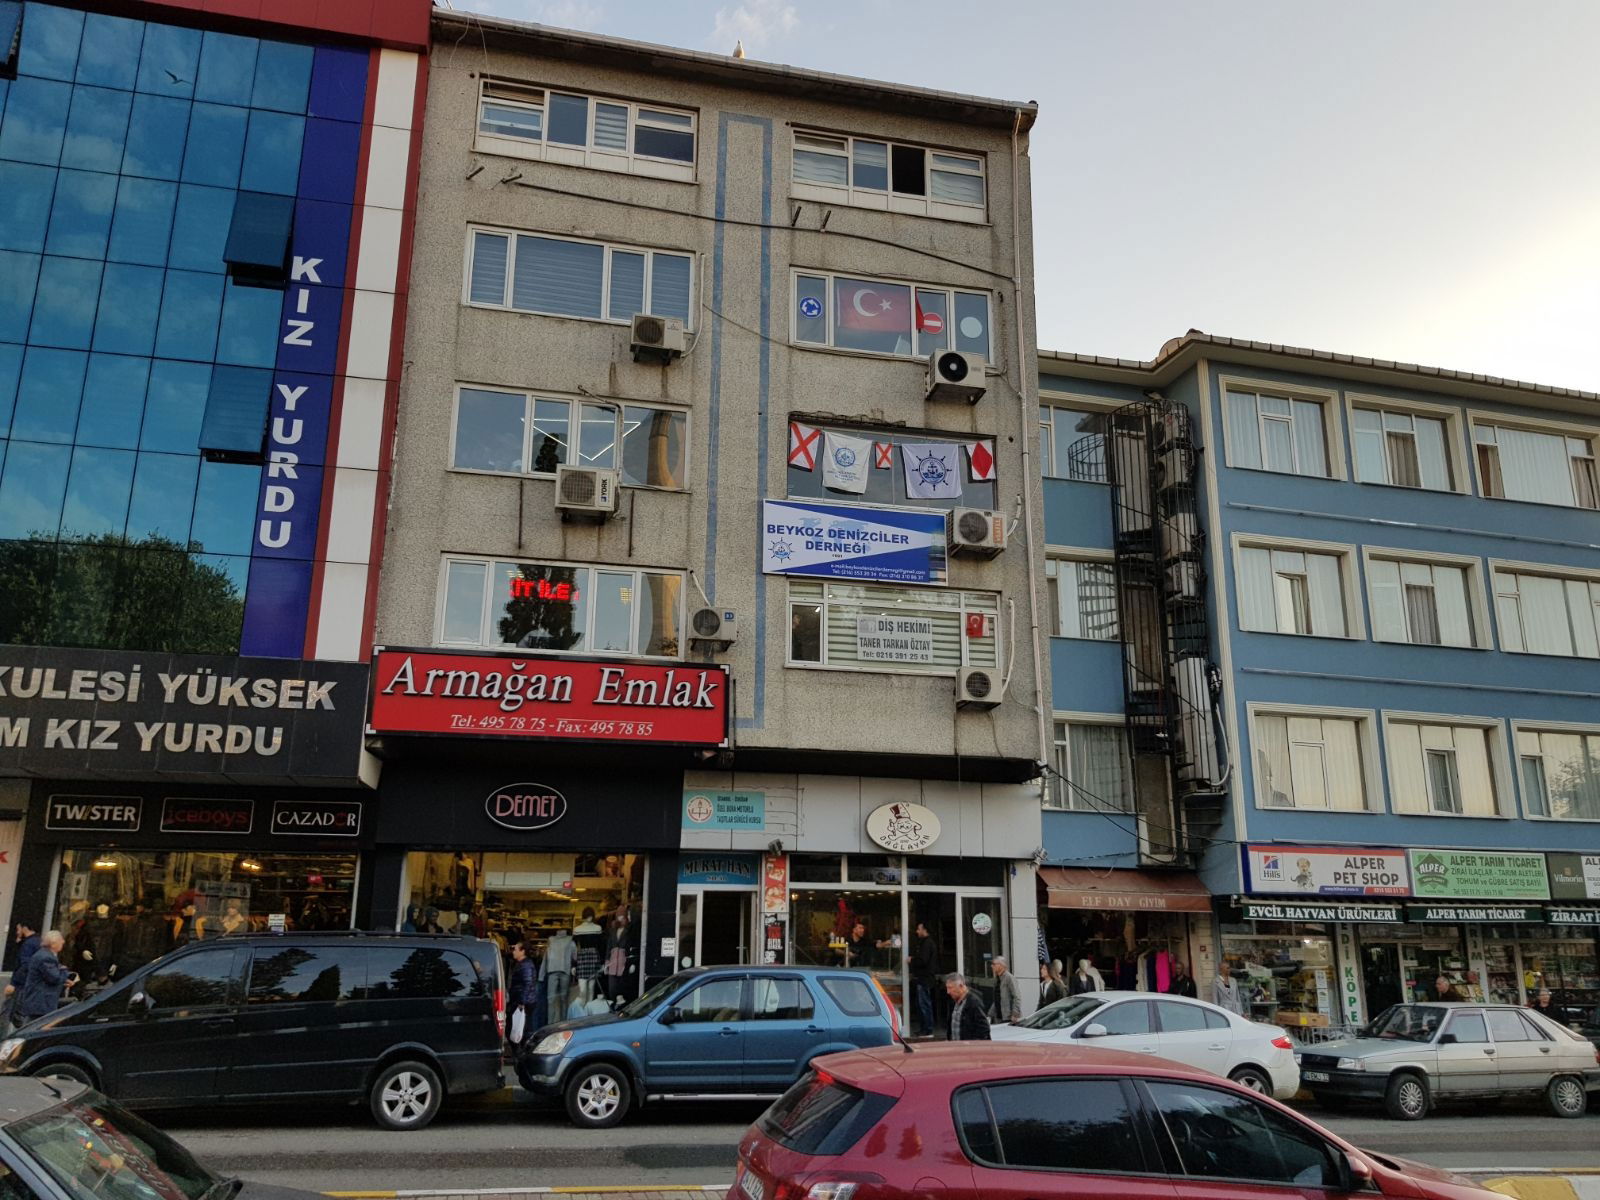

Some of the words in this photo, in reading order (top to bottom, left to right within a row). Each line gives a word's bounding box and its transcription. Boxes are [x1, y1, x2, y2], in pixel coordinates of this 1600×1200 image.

[283, 256, 324, 346] KIZ
[259, 383, 309, 548] YURDU
[767, 524, 824, 538] BEYKOZ
[828, 528, 909, 544] DENİZCİLER
[805, 541, 867, 554] DERNEĞİ
[878, 618, 894, 634] DİŞ
[897, 619, 931, 634] HEKİMİ
[859, 637, 881, 649] TANER
[883, 638, 909, 650] TARKAN
[910, 637, 931, 651] ÖZTAY
[863, 650, 874, 658] Tel:
[876, 651, 893, 659] 0216
[158, 668, 338, 711] YÜKSEK
[382, 656, 573, 712] Armağan
[593, 667, 719, 709] Emlak
[450, 713, 476, 729] Tel:
[479, 715, 505, 730] 495
[508, 716, 525, 731] 78
[526, 717, 545, 731] 75
[556, 719, 587, 733] Fax:
[590, 721, 615, 735] 495
[618, 722, 635, 735] 78
[637, 722, 653, 736] 85
[44, 718, 121, 750] KIZ
[134, 721, 284, 756] YURDU
[496, 795, 557, 816] DEMET
[54, 804, 136, 823] TWISTER
[277, 811, 357, 828] CAZADOR
[880, 834, 930, 850] DAĞLAYAN
[684, 860, 722, 875] MURAT
[727, 860, 751, 876] HAN
[1344, 857, 1385, 870] ALPER
[1419, 863, 1446, 874] ALPER
[1450, 855, 1477, 867] ALPER
[1479, 856, 1505, 867] TARIM
[1585, 857, 1600, 866] AL
[1334, 872, 1357, 884] PET
[1362, 873, 1399, 886] SHOP
[1498, 869, 1517, 877] TARIM
[1554, 872, 1584, 883] Vilmorin
[1456, 877, 1479, 885] TOHUM
[1108, 896, 1132, 907] DAY
[1139, 897, 1166, 908] GİYİM
[1249, 904, 1285, 918] EVCİL
[1286, 906, 1336, 919] HAYVAN
[1337, 905, 1397, 920] ÜRÜNLERİ
[1426, 908, 1457, 920] ALPER
[1457, 909, 1486, 920] TARIM
[1487, 906, 1526, 920] TİCARET
[1551, 909, 1594, 922] ZİRAAT
